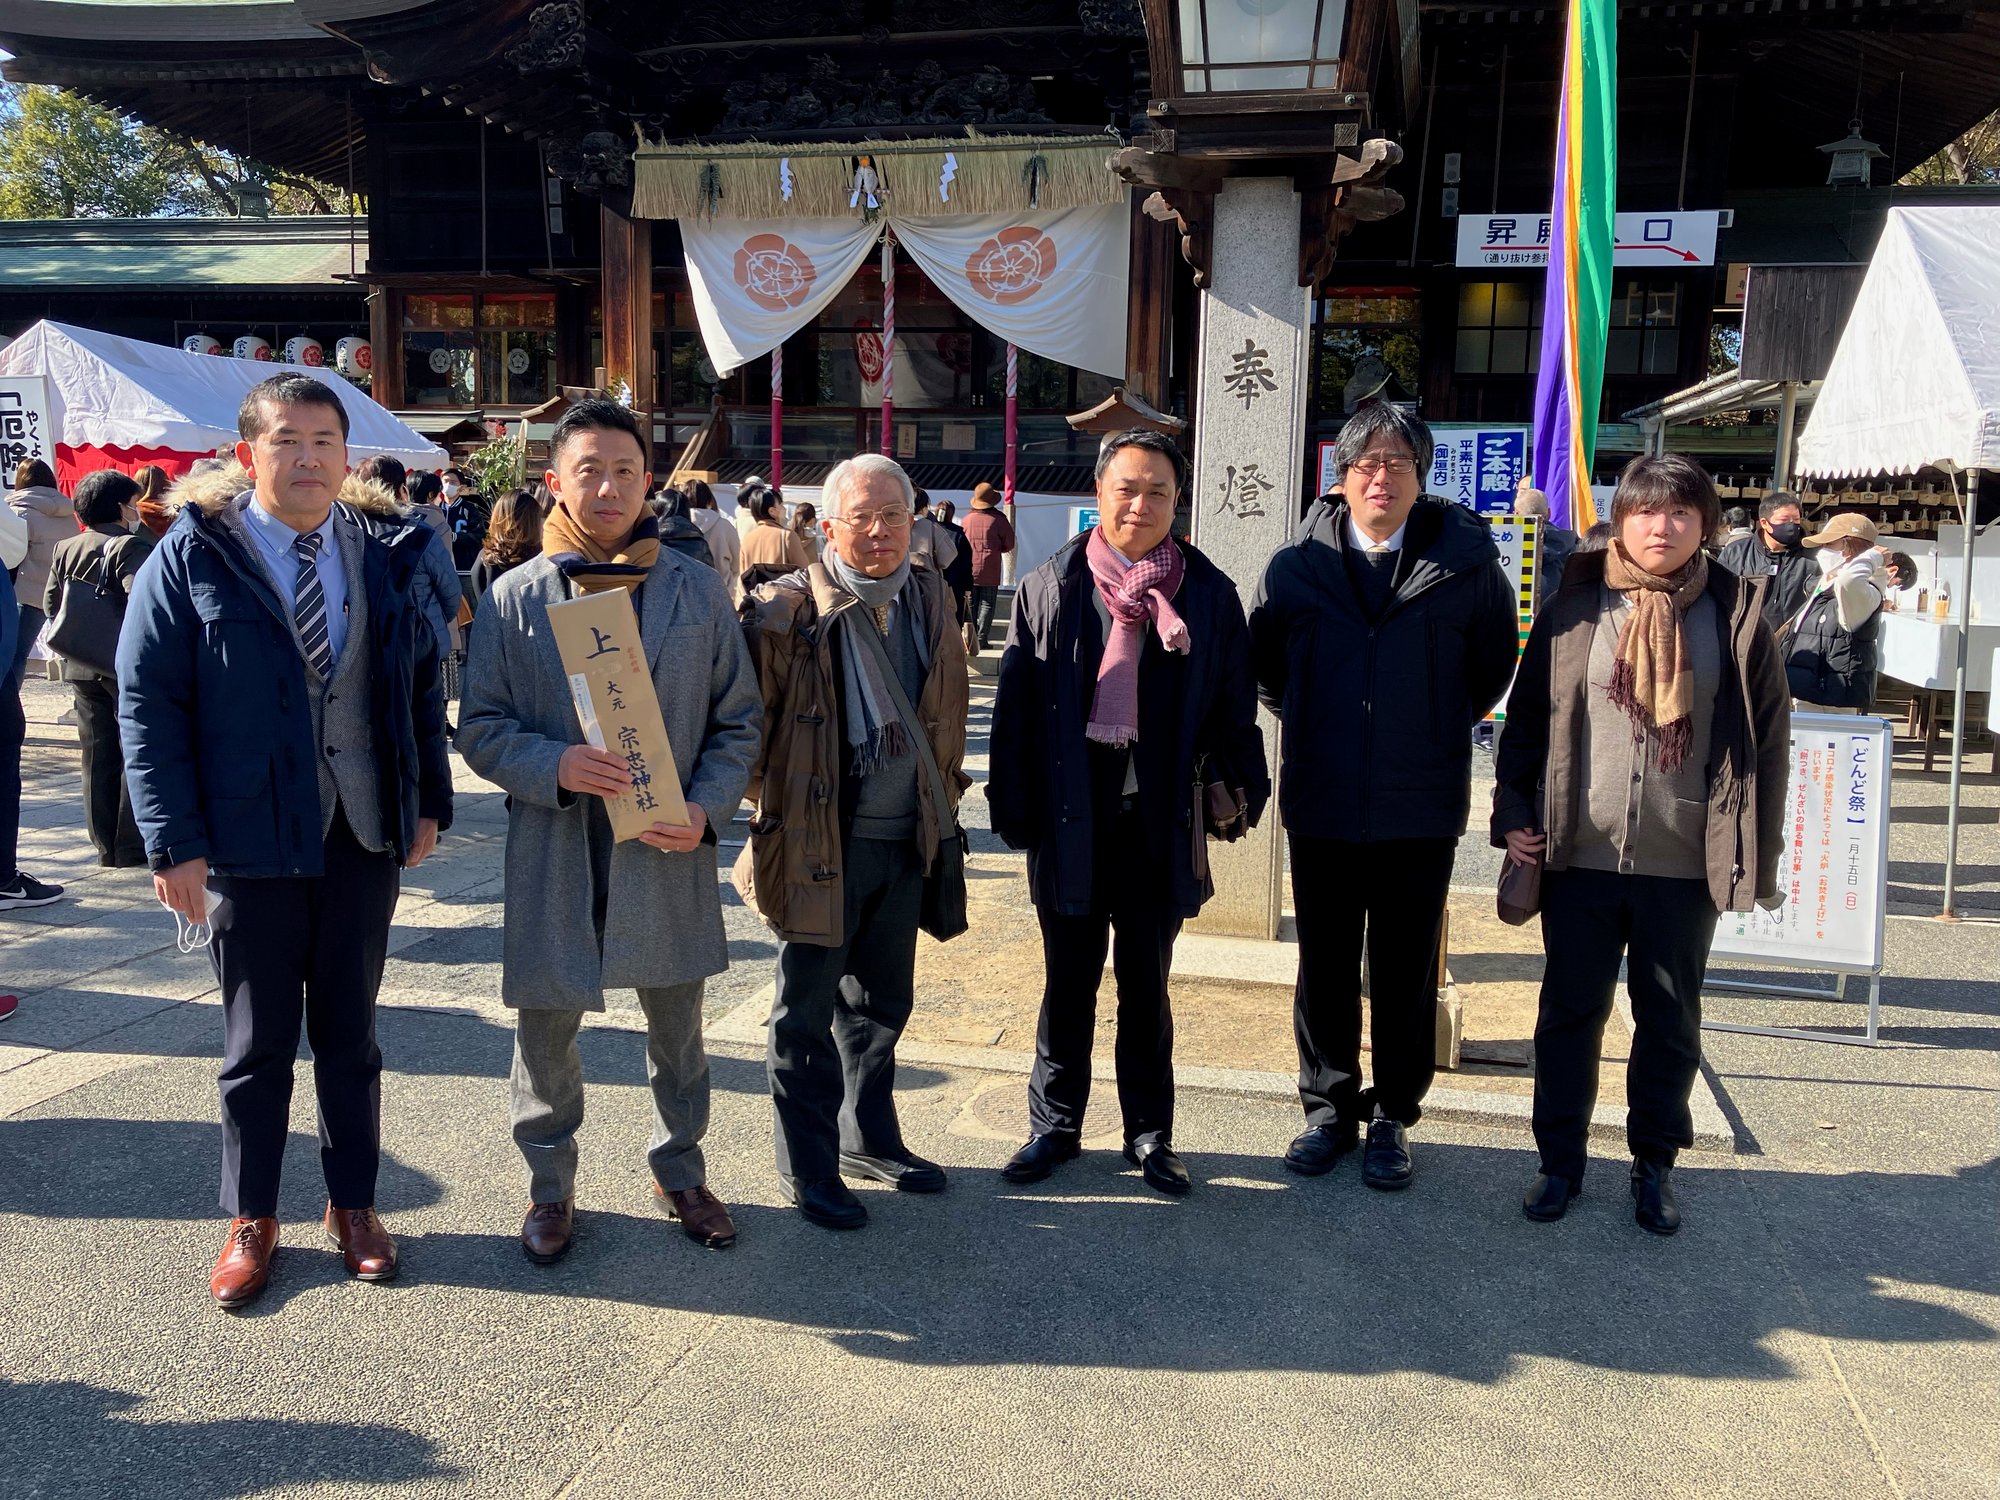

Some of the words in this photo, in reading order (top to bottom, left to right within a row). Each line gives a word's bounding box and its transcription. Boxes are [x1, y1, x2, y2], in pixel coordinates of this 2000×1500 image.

[1214, 338, 1280, 519] 奉燈
[1433, 443, 1449, 487] （御垣内）
[585, 627, 621, 660] 上
[607, 680, 627, 712] 大元
[617, 726, 660, 813] 宗忠神社
